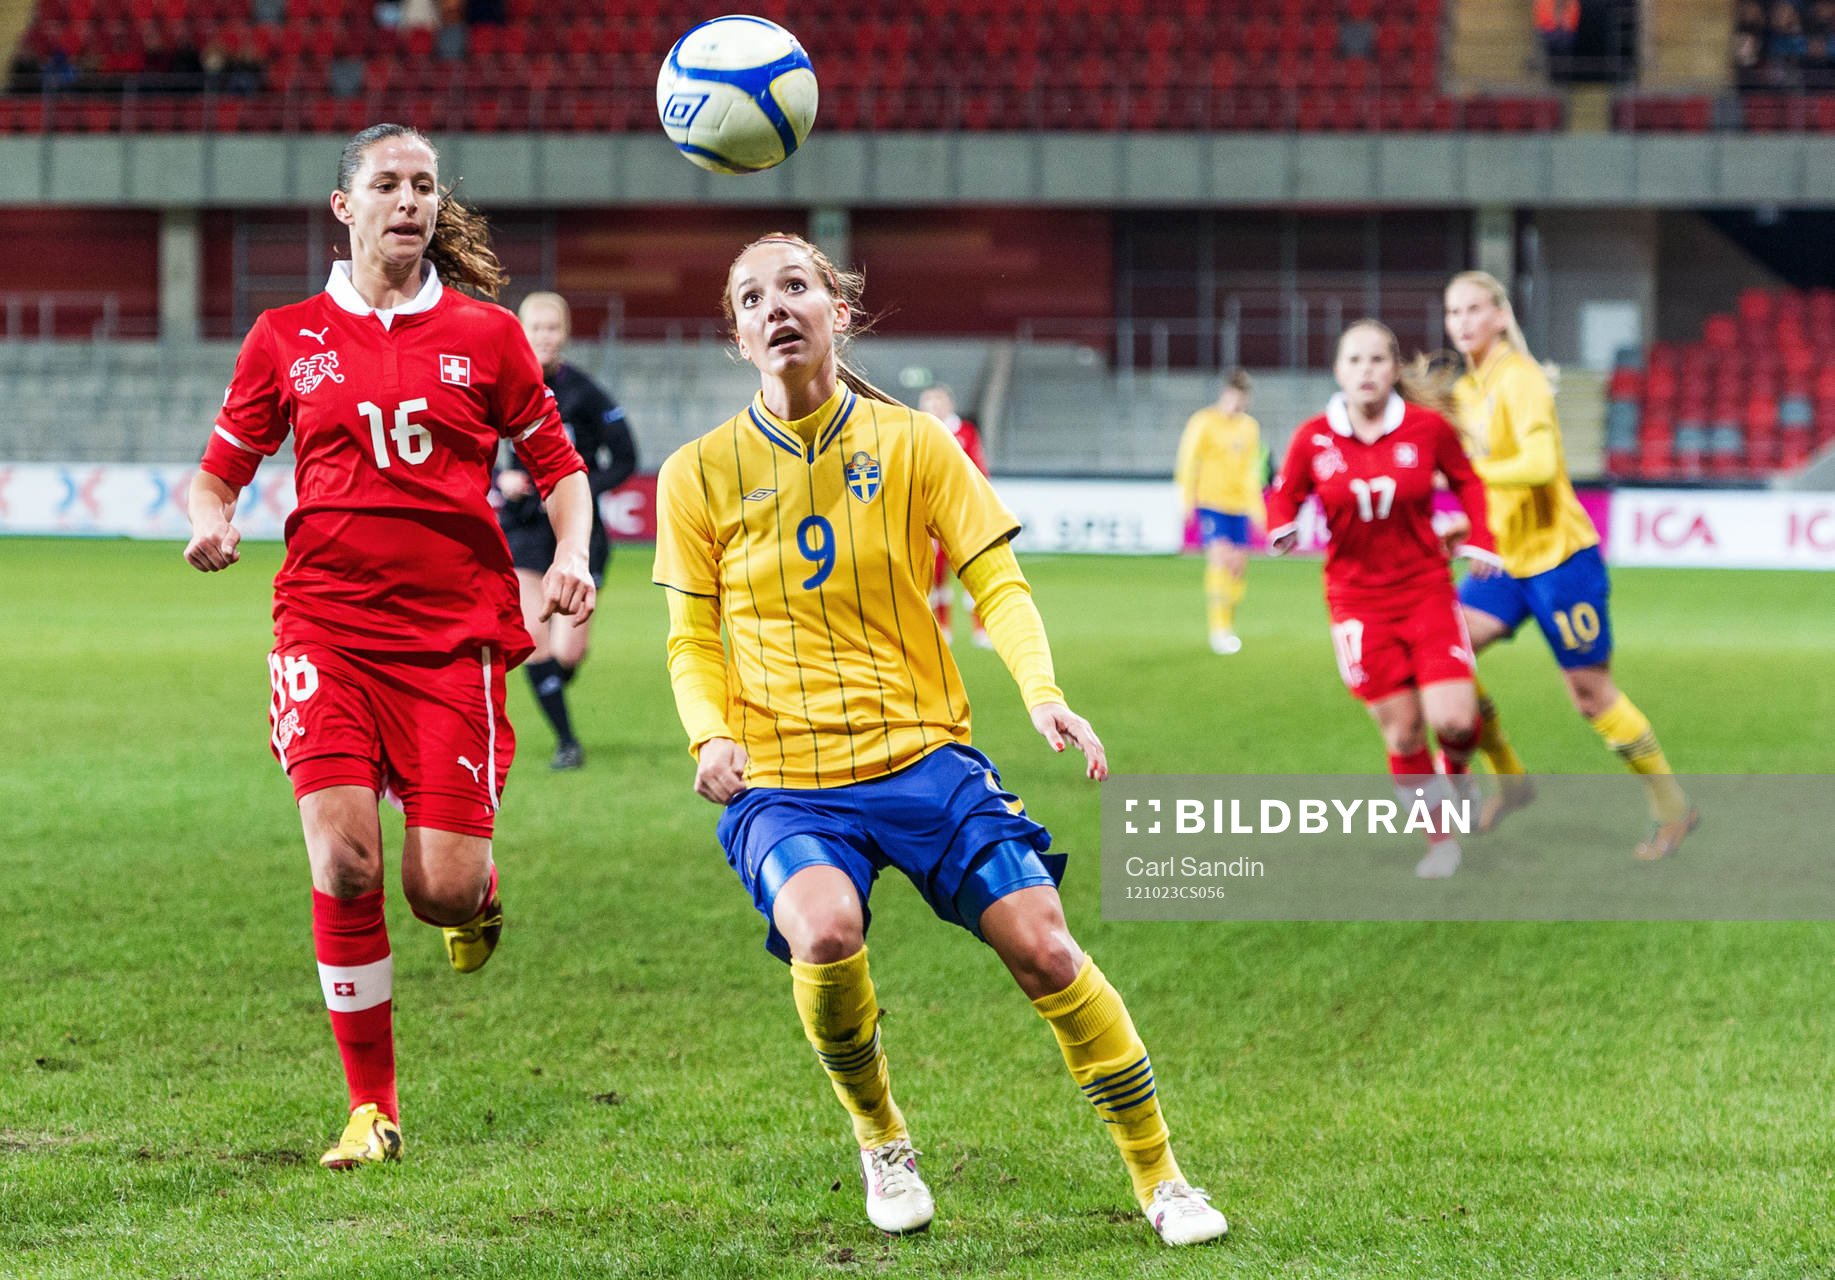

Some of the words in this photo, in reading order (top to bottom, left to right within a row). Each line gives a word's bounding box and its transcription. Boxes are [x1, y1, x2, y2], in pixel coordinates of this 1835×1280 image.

[357, 397, 433, 469] 16
[1350, 475, 1397, 522] 17
[1634, 508, 1717, 549] ICA
[796, 515, 836, 591] 9
[1553, 602, 1600, 650] 10
